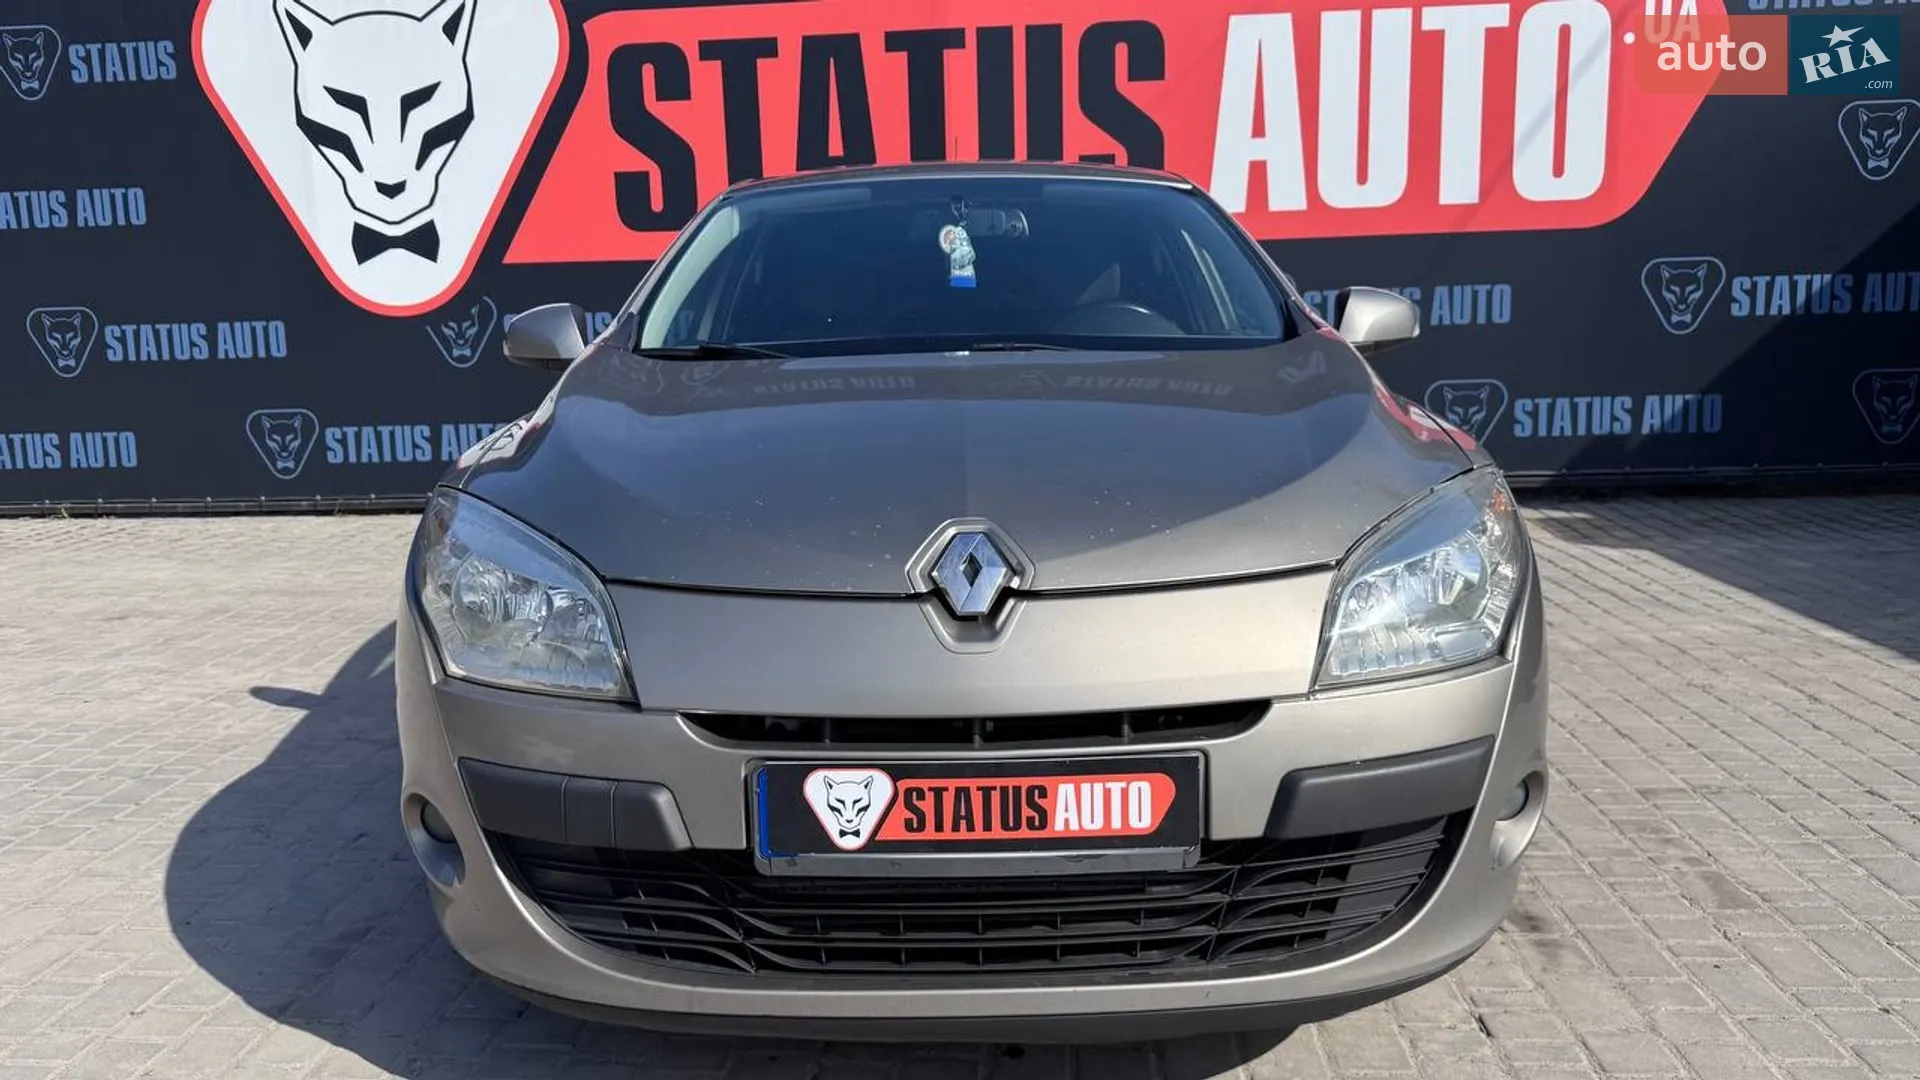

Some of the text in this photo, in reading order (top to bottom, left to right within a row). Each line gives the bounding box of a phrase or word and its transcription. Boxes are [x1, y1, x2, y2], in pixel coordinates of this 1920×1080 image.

[68, 40, 177, 83] STATUS
[607, 19, 1167, 232] STATUS
[1209, 0, 1612, 213] AUTO
[76, 187, 147, 228] AUTO
[1430, 283, 1512, 325] AUTO
[1730, 274, 1853, 317] STATUS
[104, 319, 288, 362] STATUS AUTO
[1513, 394, 1723, 437] STATUS AUTO
[70, 431, 138, 468] AUTO
[324, 423, 508, 464] STATUS AUT
[903, 780, 1153, 833] STATUS AUTO
